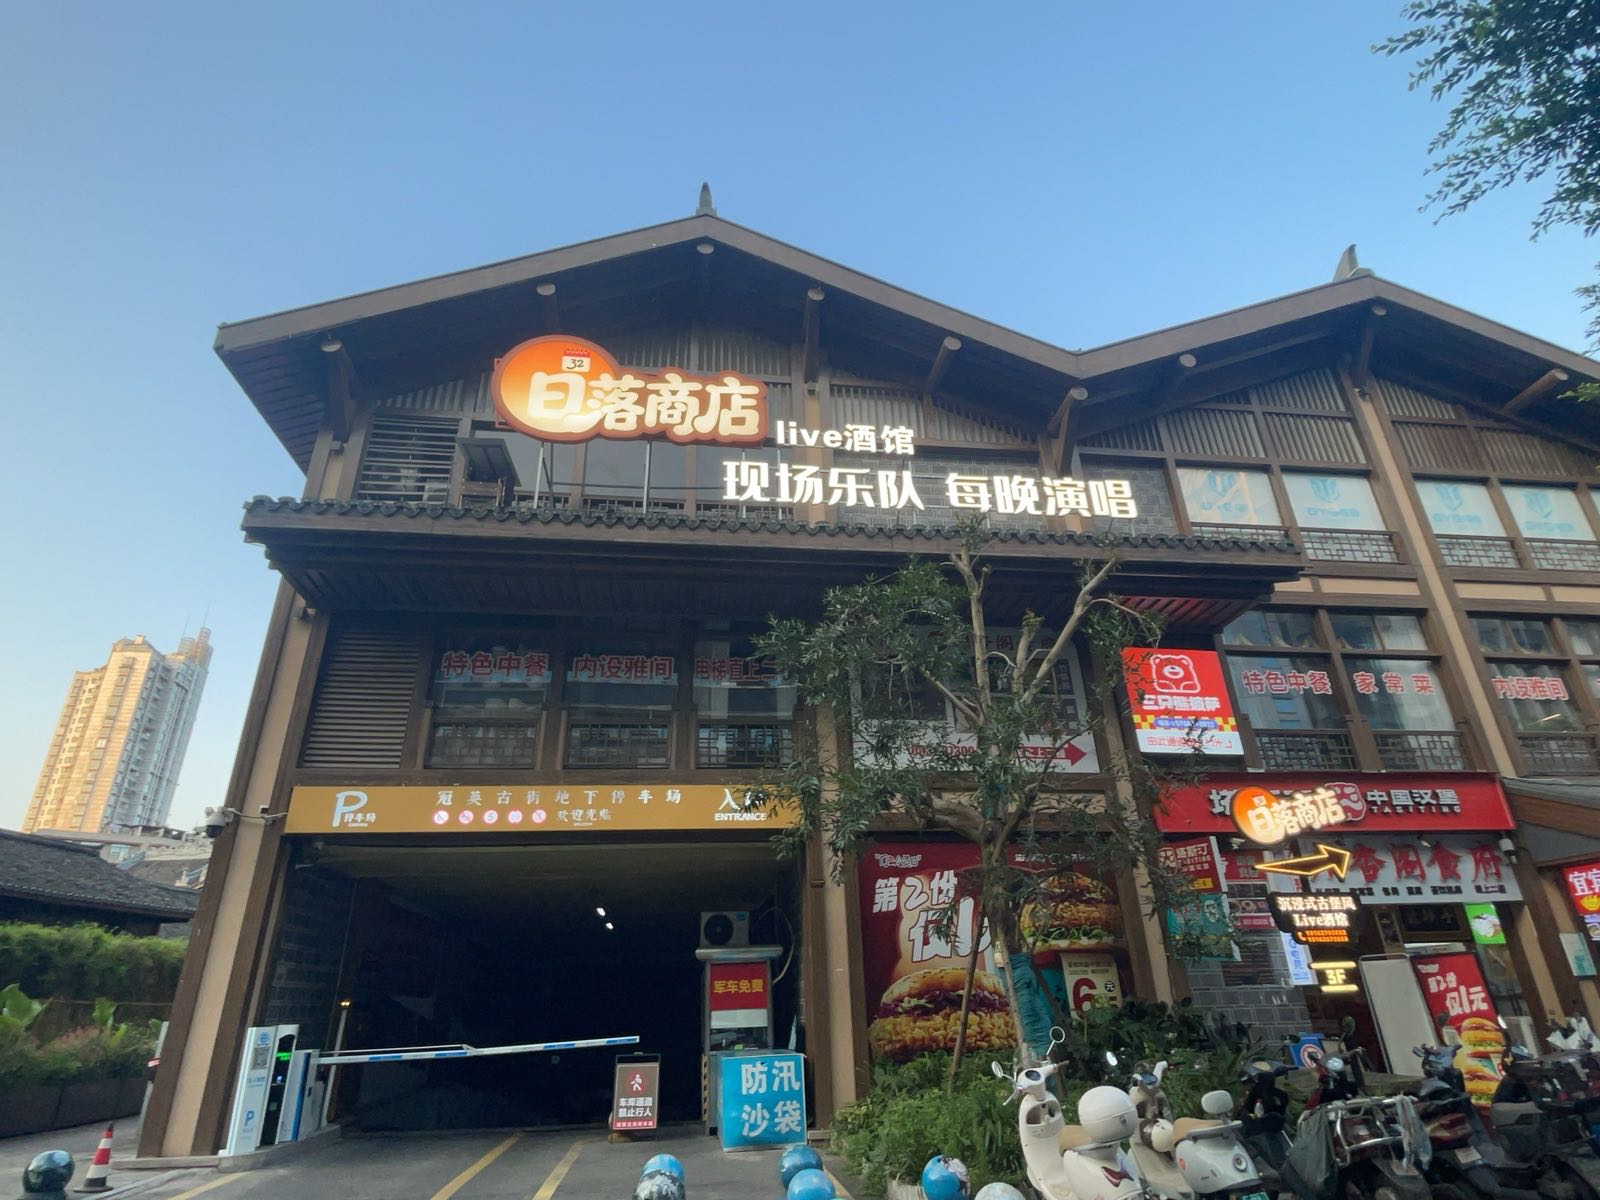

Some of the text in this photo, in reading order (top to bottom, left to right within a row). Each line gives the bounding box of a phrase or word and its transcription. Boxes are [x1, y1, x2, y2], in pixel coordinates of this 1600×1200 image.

[566, 358, 585, 370] 32
[527, 371, 760, 436] 日落商店
[776, 421, 914, 455] live酒馆
[722, 461, 1138, 519] 现场乐队 每晚演唱
[442, 652, 550, 680] 特色中餐
[573, 656, 673, 681] 内设雅间
[695, 657, 790, 681] 电梯直上二
[1242, 670, 1333, 696] 特色中餐
[1353, 671, 1436, 695] 家常菜
[1491, 676, 1569, 700] 内设雅间
[332, 790, 368, 828] P
[435, 789, 682, 807] 冠英古街地下停车场
[1366, 789, 1461, 805] 中国汉堡
[715, 812, 767, 821] ENTRANCE
[1247, 787, 1346, 840] 日落商店
[1371, 806, 1462, 814] TASITING
[873, 869, 958, 914] 第2份
[1276, 896, 1357, 911] 沉浸式古堡风
[1292, 912, 1349, 927] Live酒馆
[713, 978, 764, 994] 军车免费
[1325, 968, 1347, 985] 3F
[1445, 985, 1489, 1016] 仅1元
[741, 1060, 801, 1096] 防汛
[741, 1100, 802, 1138] 沙袋
